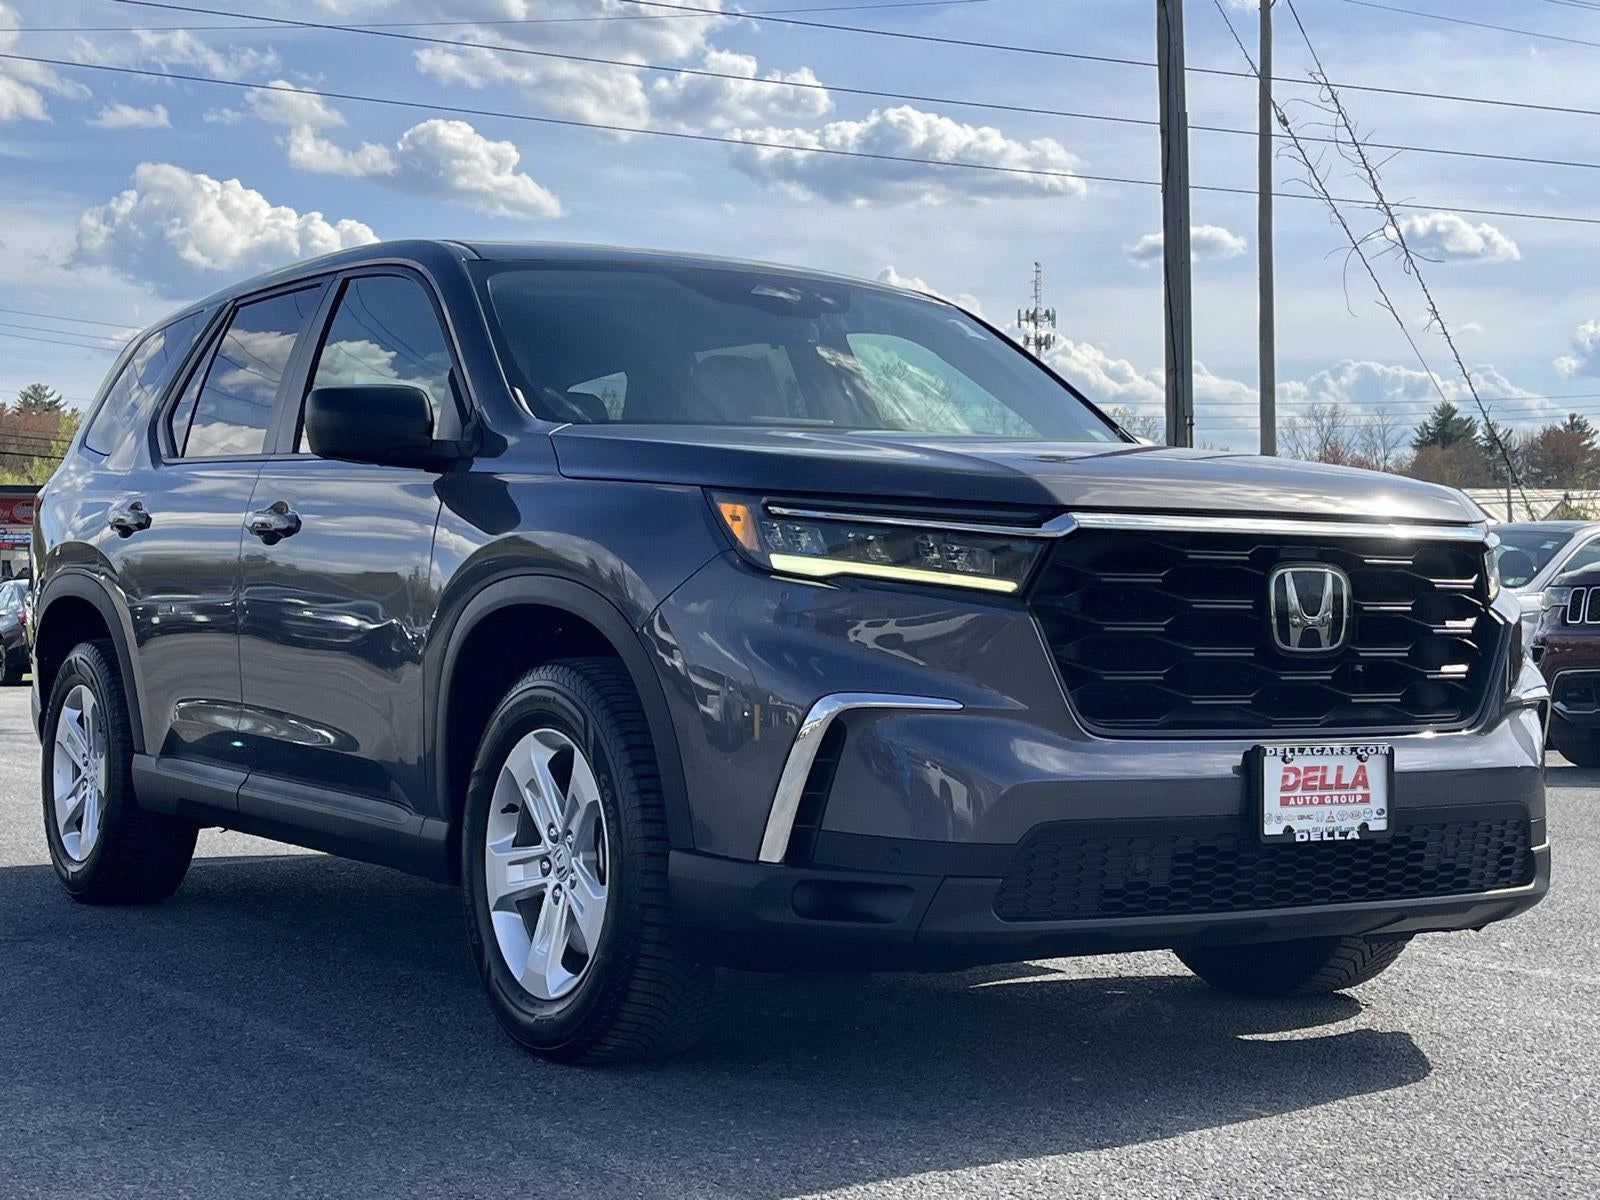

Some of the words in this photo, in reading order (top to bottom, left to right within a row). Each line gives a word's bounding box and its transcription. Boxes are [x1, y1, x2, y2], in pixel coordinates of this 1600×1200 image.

[1265, 745, 1390, 757] DELLACARS.COM
[1280, 764, 1370, 792] DELLA
[1288, 796, 1320, 806] AUTO
[1324, 794, 1363, 804] GROUP
[1295, 830, 1360, 842] DELLA
